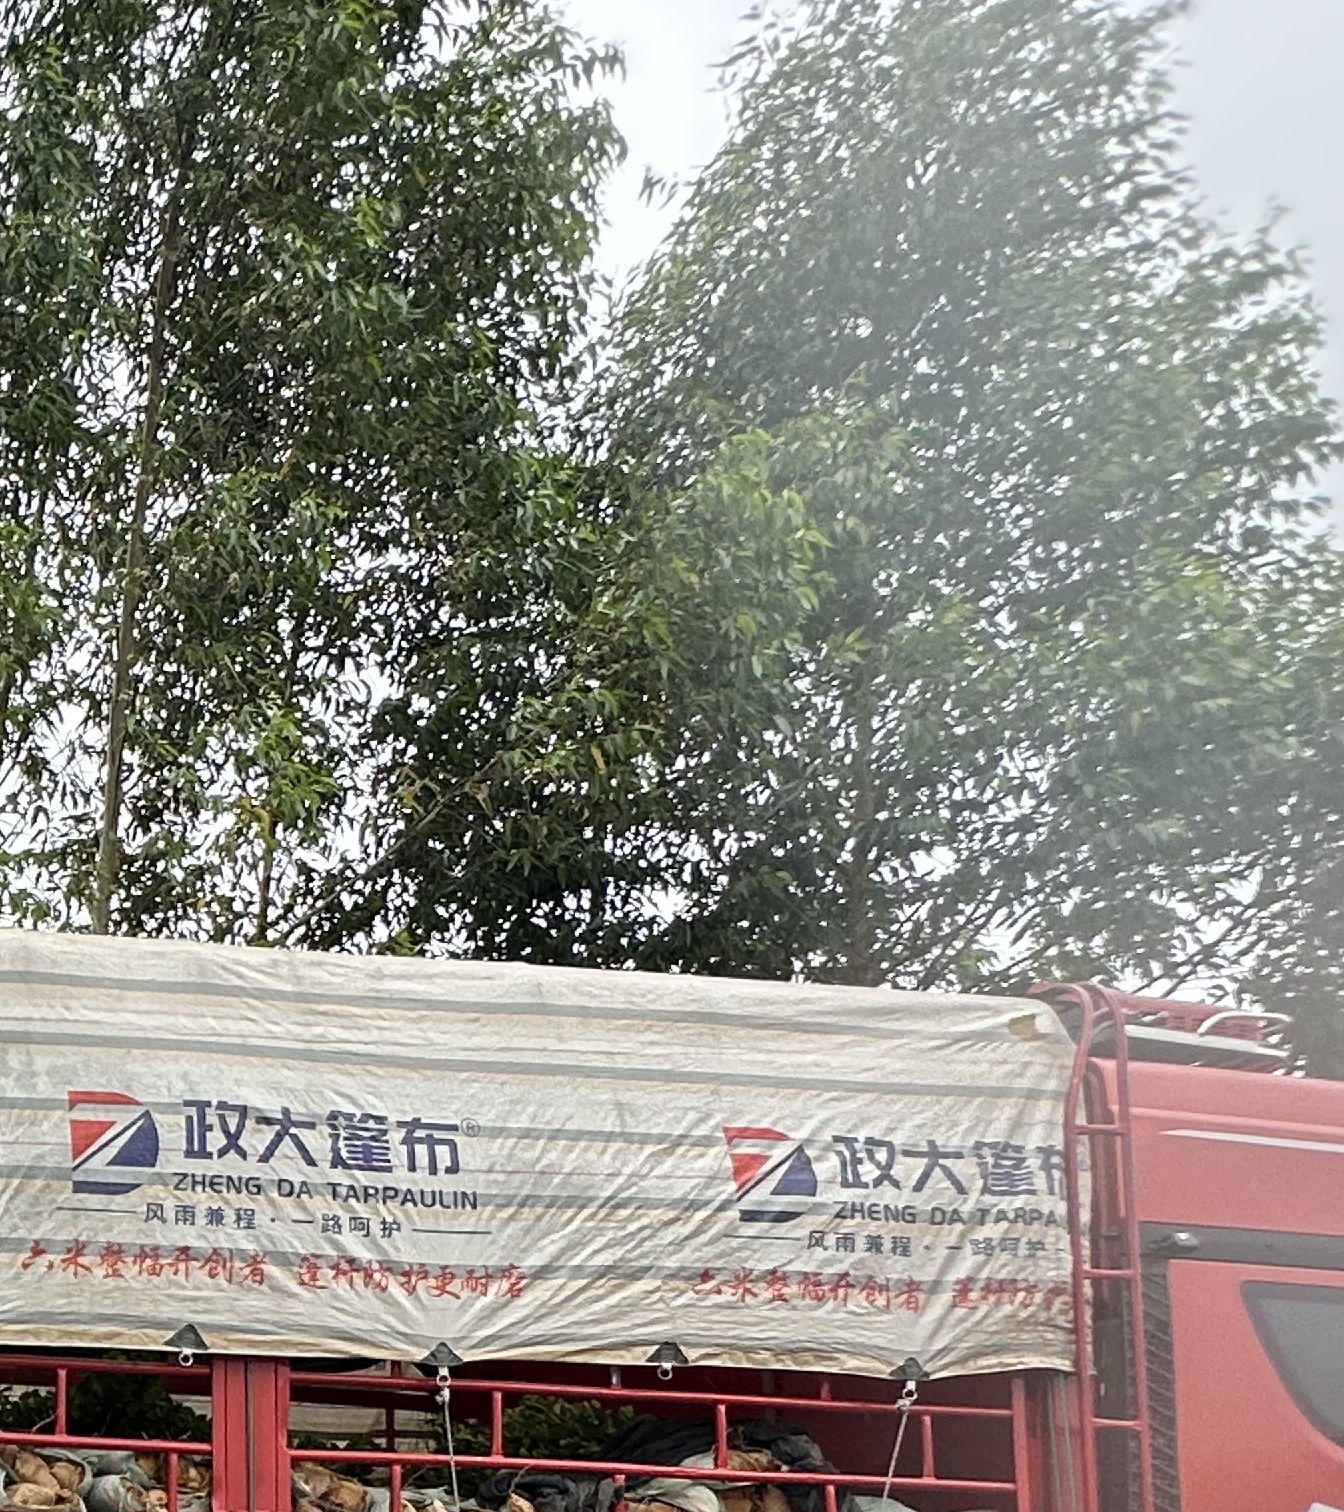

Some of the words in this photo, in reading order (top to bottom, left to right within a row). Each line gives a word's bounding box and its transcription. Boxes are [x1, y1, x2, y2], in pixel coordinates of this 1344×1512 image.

[172, 1172, 262, 1196] ZHENG
[277, 1178, 312, 1199] DA
[326, 1181, 478, 1211] TARPAULIN
[833, 1200, 917, 1225] ZHENG
[930, 1206, 965, 1226] DA
[976, 1207, 1061, 1229] TARPA
